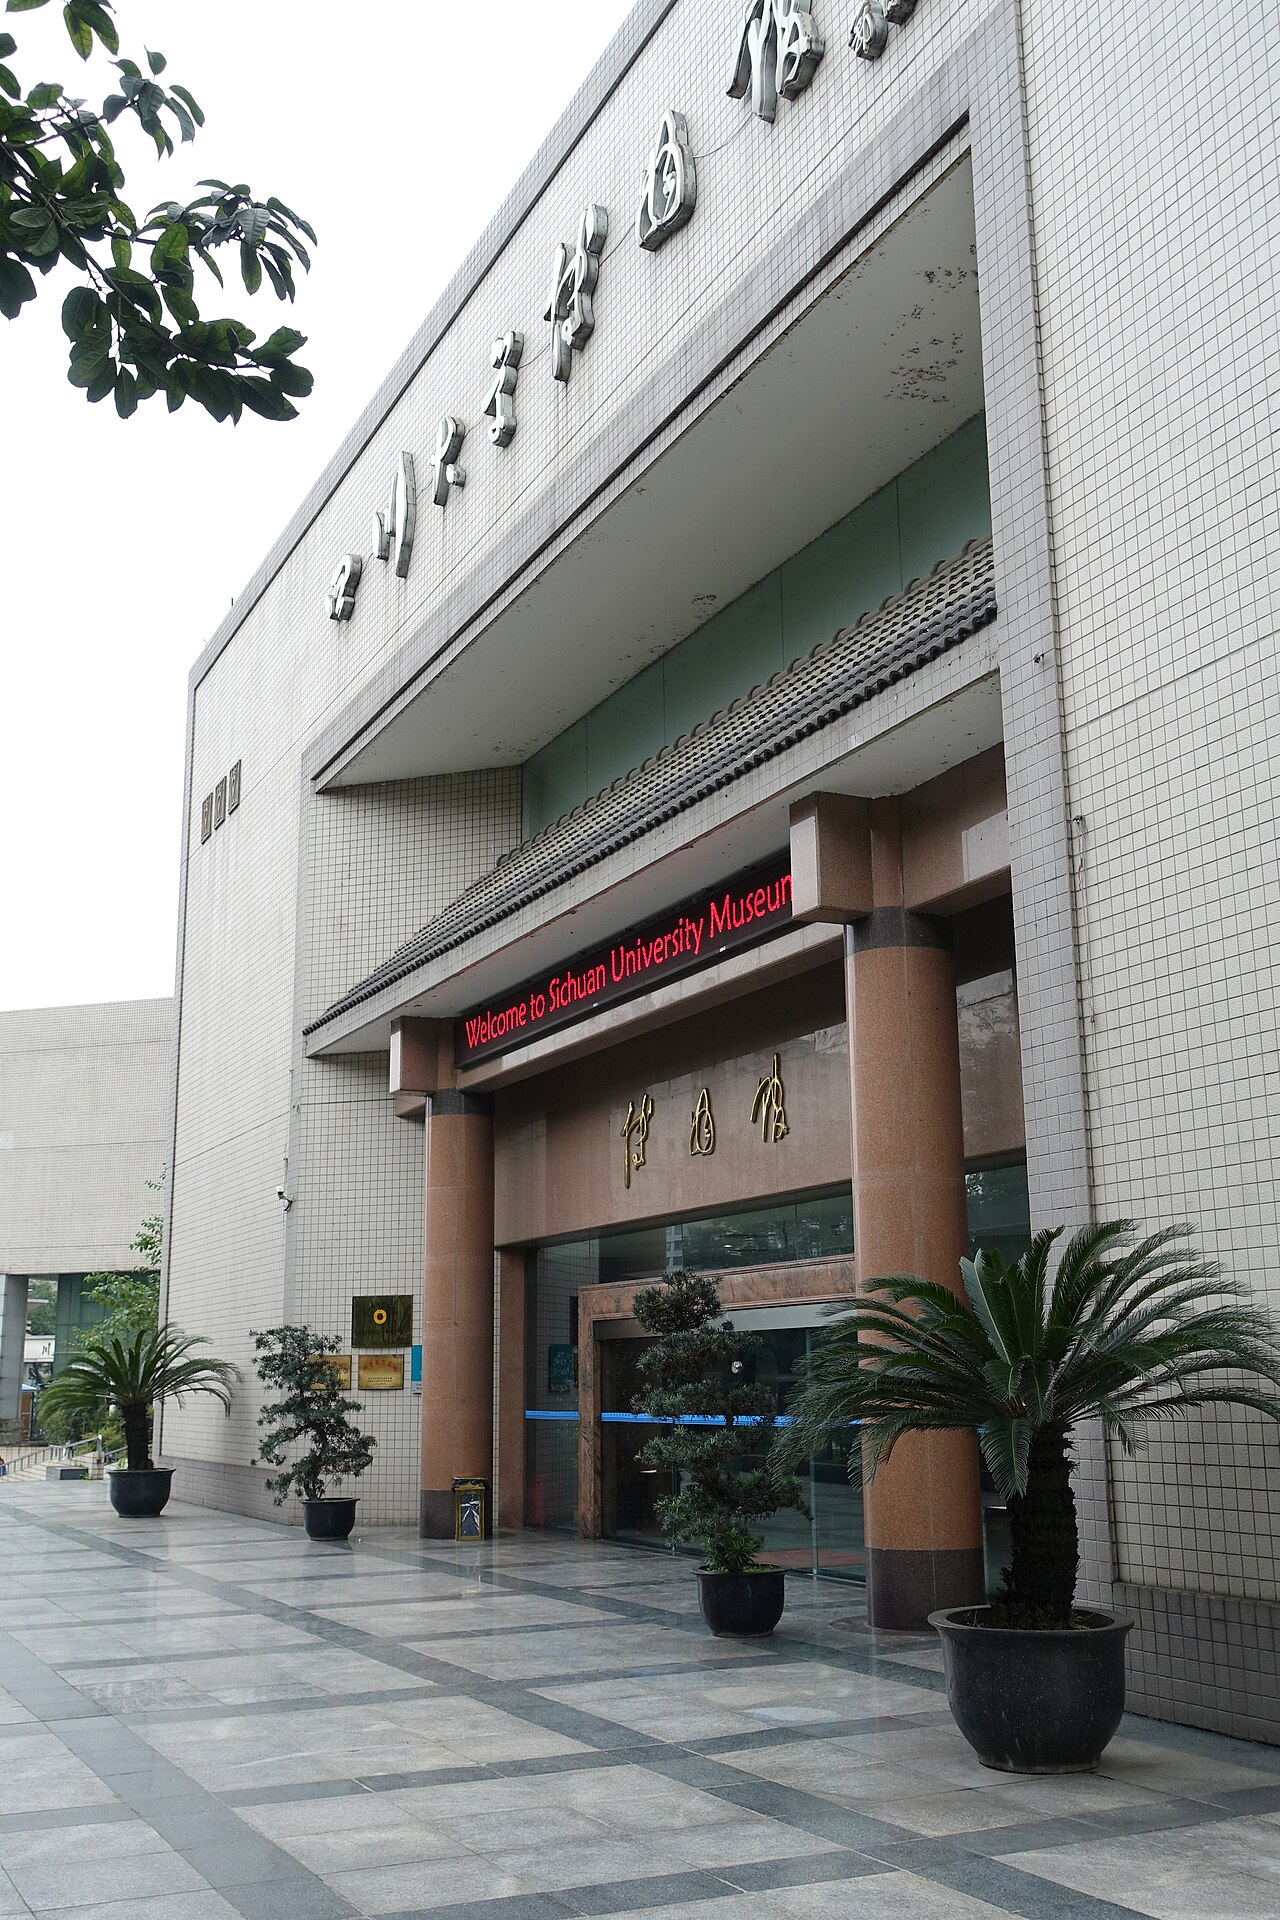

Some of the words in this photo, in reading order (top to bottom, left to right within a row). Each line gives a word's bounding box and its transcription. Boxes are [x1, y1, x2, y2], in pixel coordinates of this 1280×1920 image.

[465, 1003, 527, 1049] Welcome
[530, 993, 546, 1021] to
[549, 964, 606, 1013] Sichuan
[610, 917, 704, 983] University
